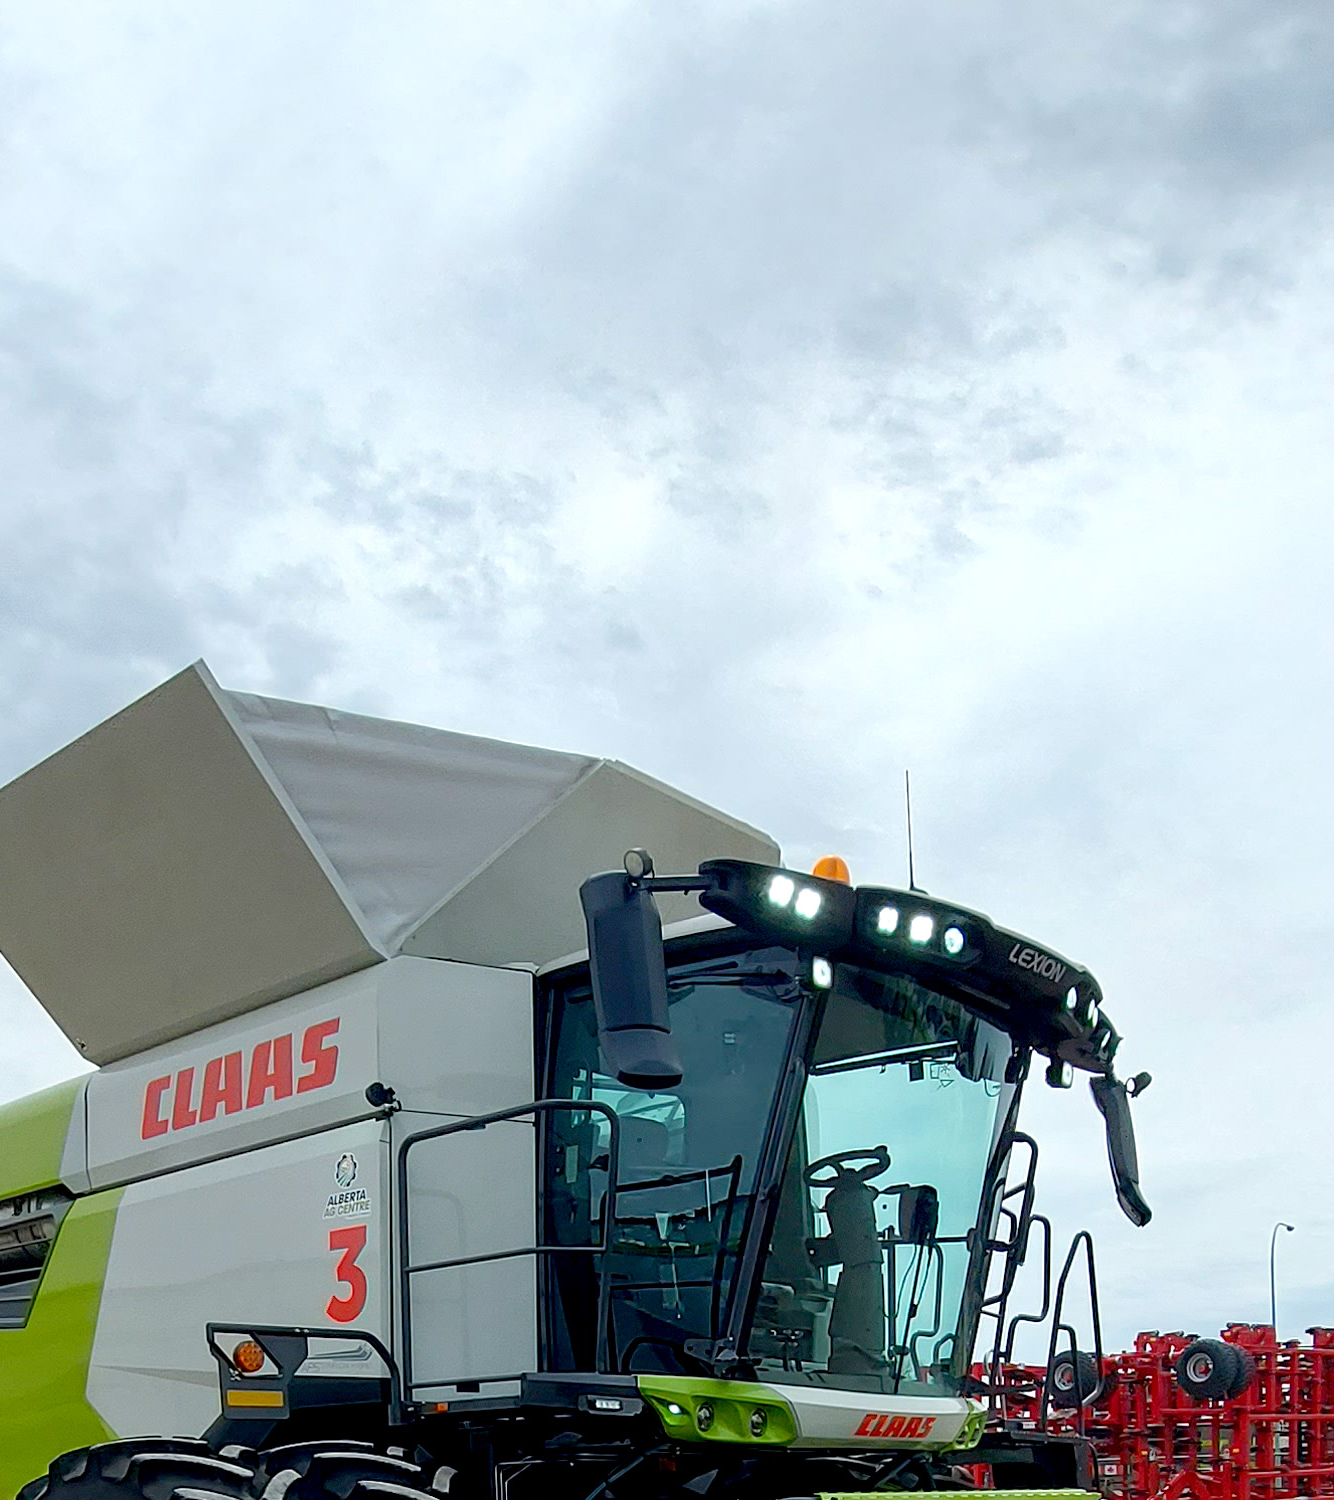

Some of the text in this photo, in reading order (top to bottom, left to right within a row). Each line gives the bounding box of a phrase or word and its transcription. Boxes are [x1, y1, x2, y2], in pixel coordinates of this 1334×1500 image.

[1008, 943, 1067, 983] LEXION
[142, 1016, 341, 1140] CLAAS
[323, 1206, 336, 1218] AG
[337, 1199, 370, 1215] CENTRE
[327, 1189, 366, 1206] ALBERTA
[326, 1224, 367, 1323] 3
[854, 1413, 937, 1438] CLAAS
